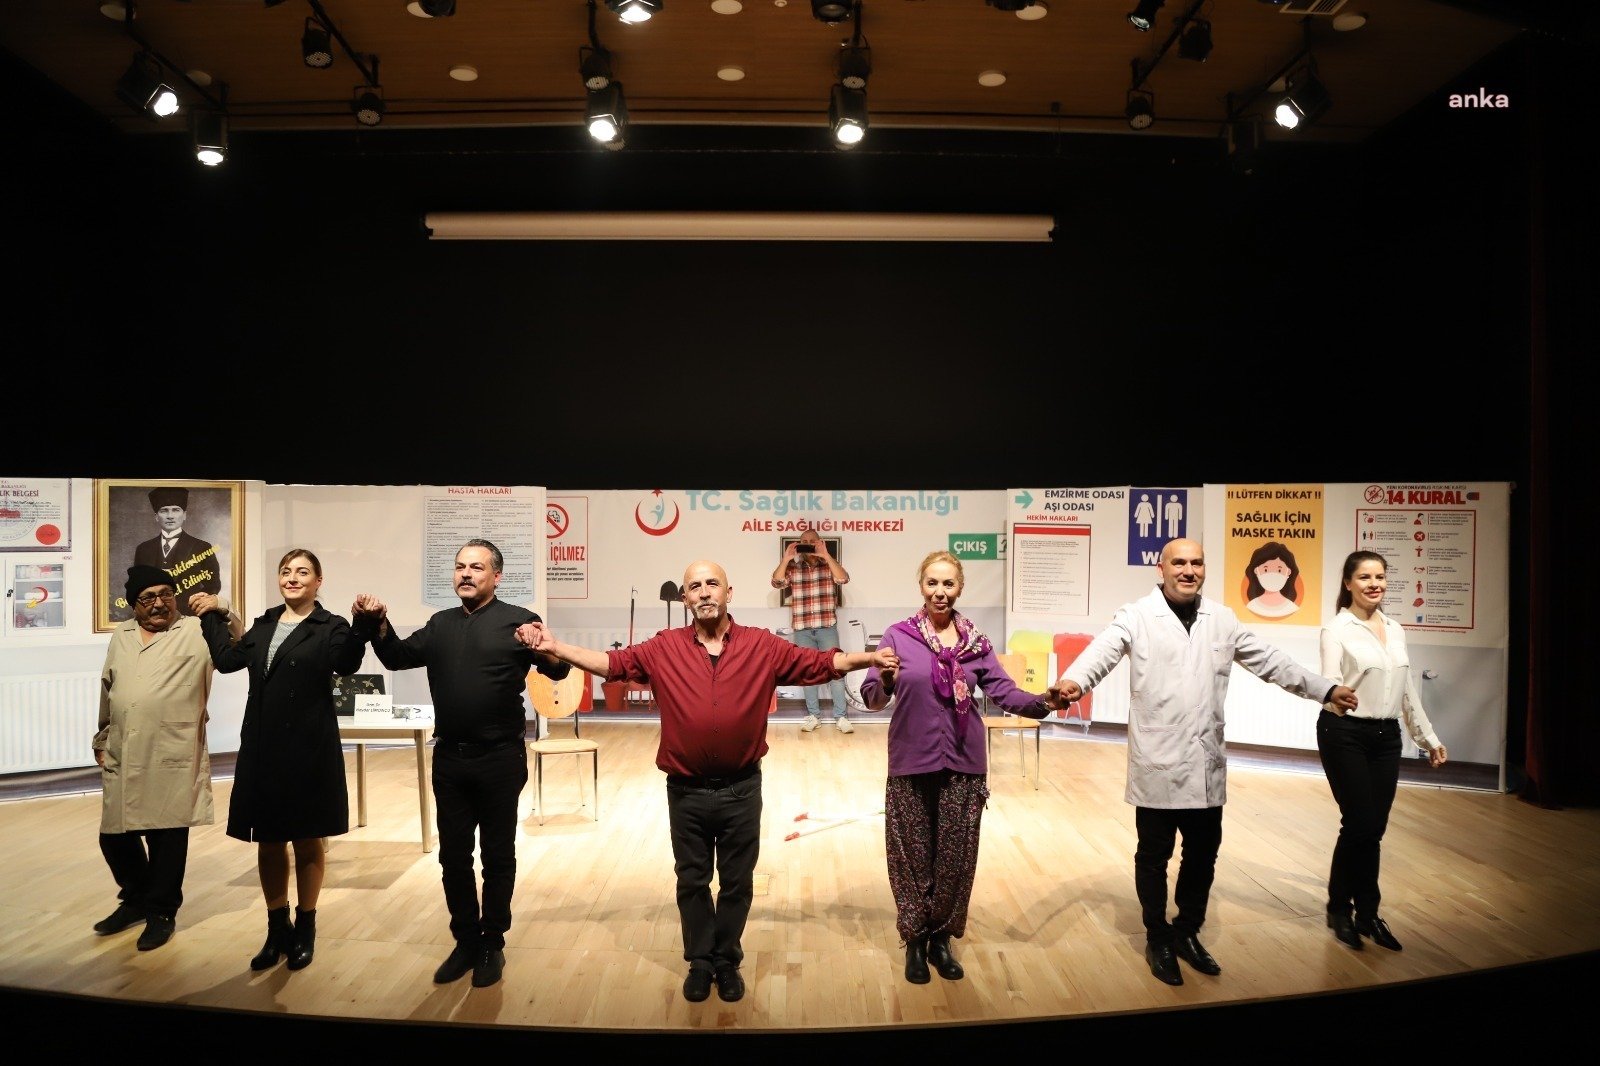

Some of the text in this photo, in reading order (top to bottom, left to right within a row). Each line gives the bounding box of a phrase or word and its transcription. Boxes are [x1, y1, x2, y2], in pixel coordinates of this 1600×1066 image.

[448, 487, 512, 495] HASTA HAKLARI
[1044, 488, 1125, 499] EMZİRME ODASI
[1235, 488, 1273, 500] LÜTFEN
[1275, 489, 1313, 500] DİKKAT
[1407, 490, 1466, 505] KURAL
[738, 490, 823, 516] Sağlık
[831, 490, 960, 516] Bakanlığı
[1044, 502, 1094, 512] AŞI ODASI
[1026, 514, 1079, 522] HEKİM HAKLARI
[1236, 510, 1311, 525] SAĞLIK İÇİN
[742, 518, 904, 532] AİLE SAĞLIĞI MERKEZİ
[1231, 527, 1316, 539] MASKE TAKIN
[550, 542, 586, 566] İÇİLMEZ
[953, 541, 988, 555] ÇIKIŞ
